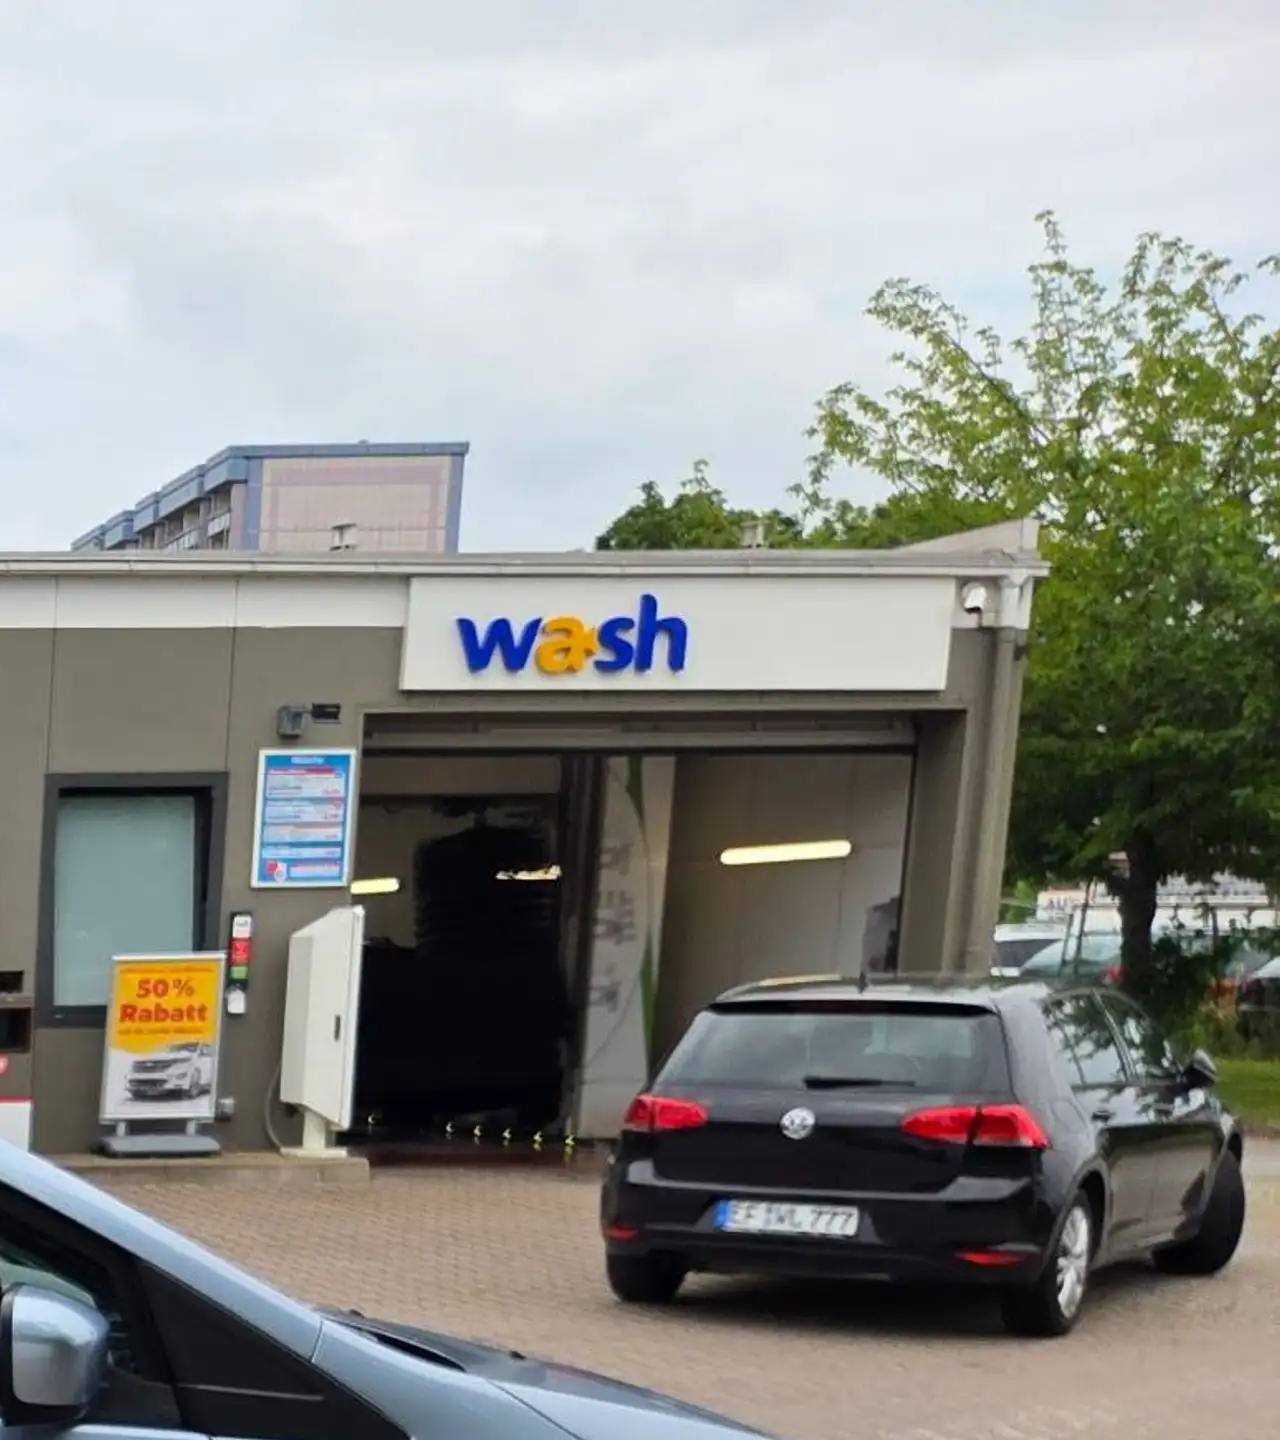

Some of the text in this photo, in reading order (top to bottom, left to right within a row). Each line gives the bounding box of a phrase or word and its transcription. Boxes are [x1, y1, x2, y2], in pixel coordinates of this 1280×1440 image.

[457, 593, 687, 674] wash
[120, 1003, 208, 1023] Rabatt
[811, 1206, 856, 1235] 777
